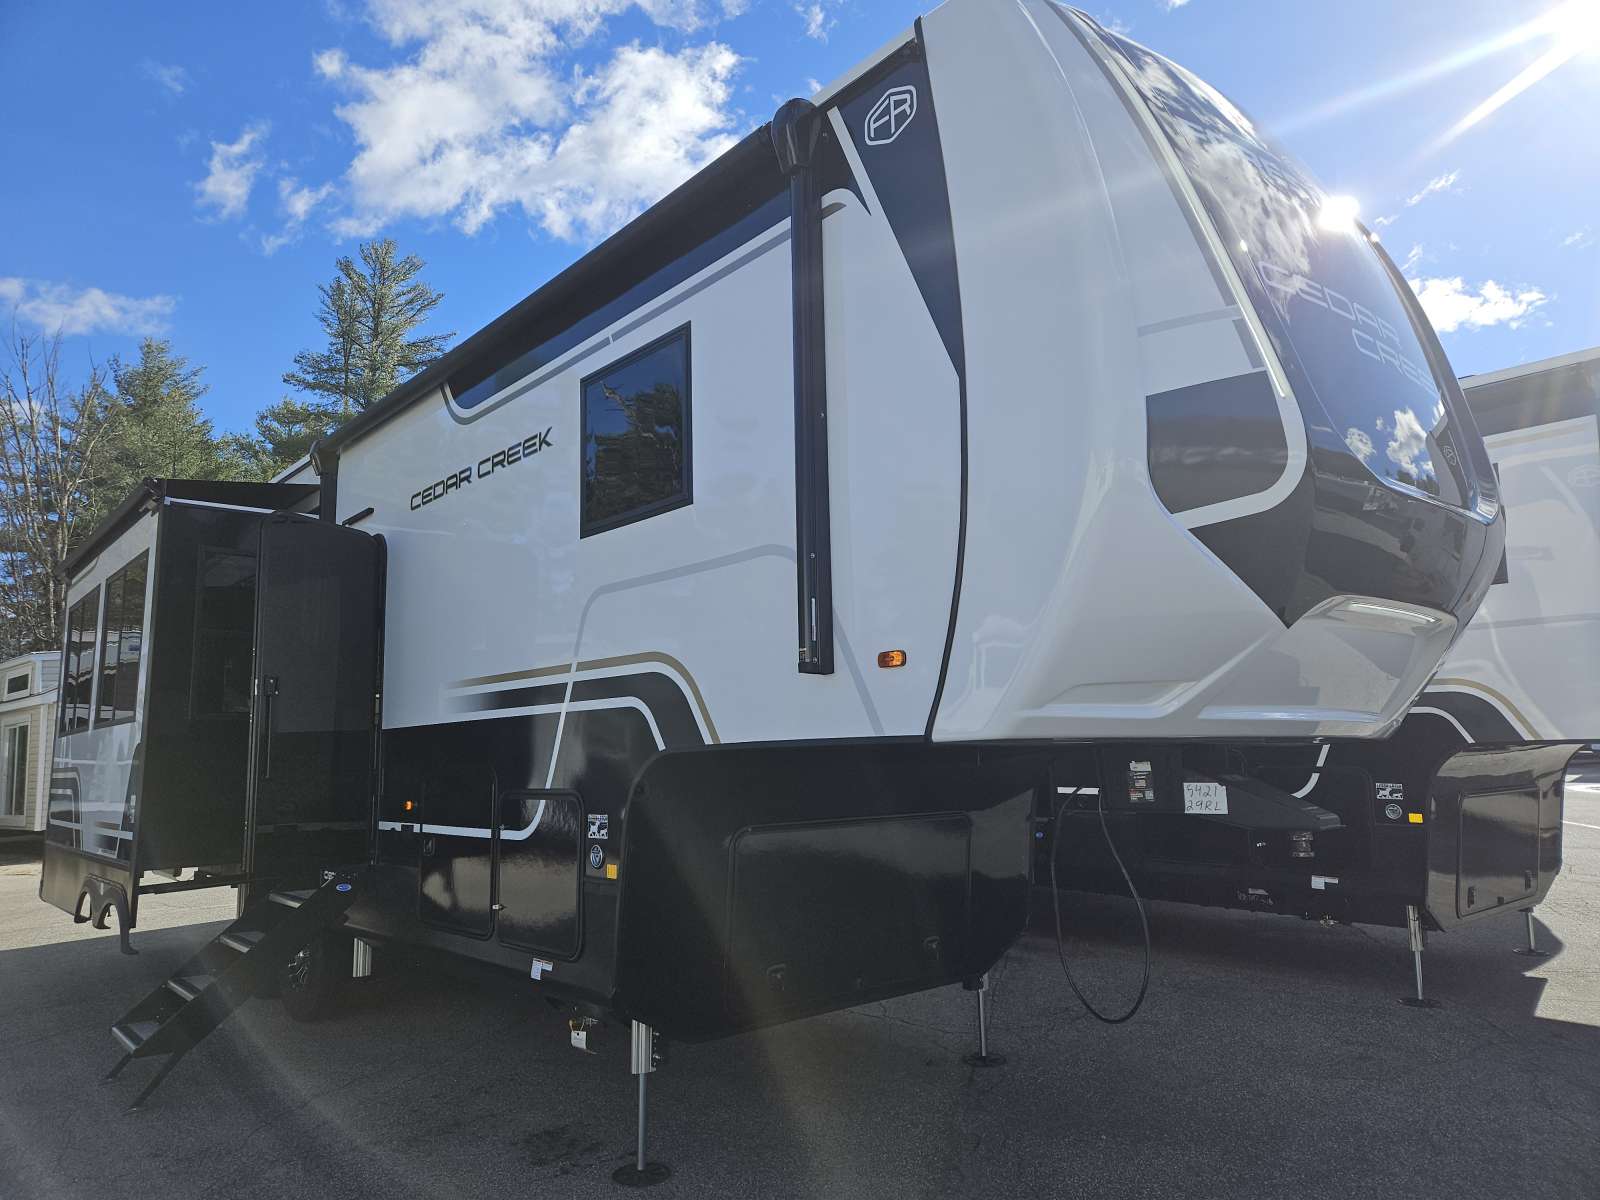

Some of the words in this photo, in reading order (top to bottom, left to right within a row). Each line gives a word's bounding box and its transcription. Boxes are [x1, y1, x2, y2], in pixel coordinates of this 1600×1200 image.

[1258, 260, 1401, 351] CEDAR
[410, 466, 473, 511] CEDAR
[477, 426, 553, 479] CREEK
